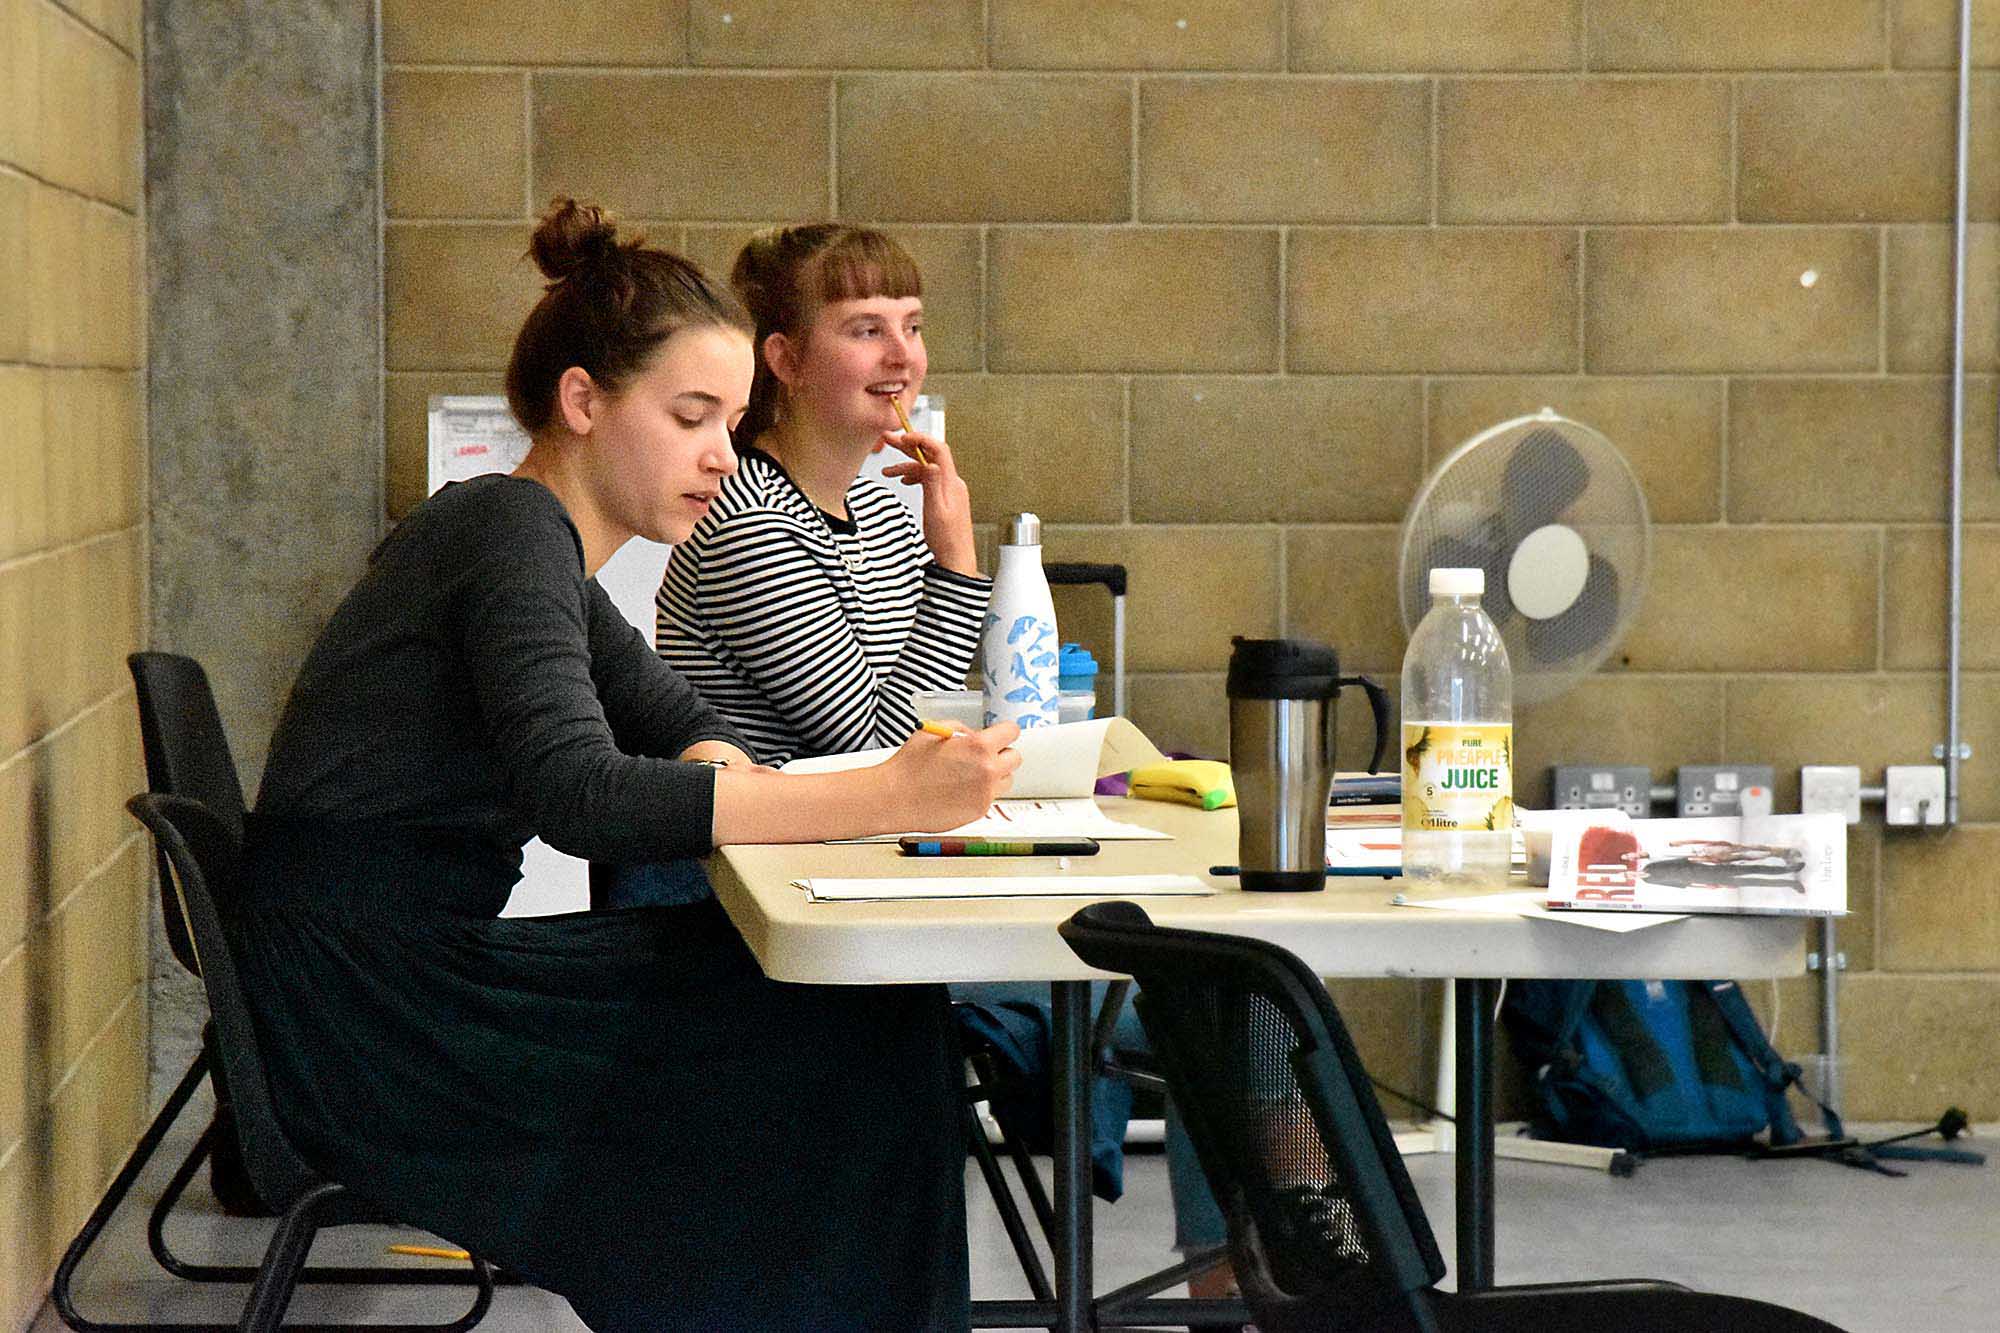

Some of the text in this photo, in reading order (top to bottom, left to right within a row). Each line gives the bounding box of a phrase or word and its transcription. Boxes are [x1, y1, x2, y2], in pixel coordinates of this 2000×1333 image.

[1462, 739, 1482, 747] PURE
[1436, 750, 1500, 765] PINEAPPLE
[1441, 768, 1498, 789] JUICE
